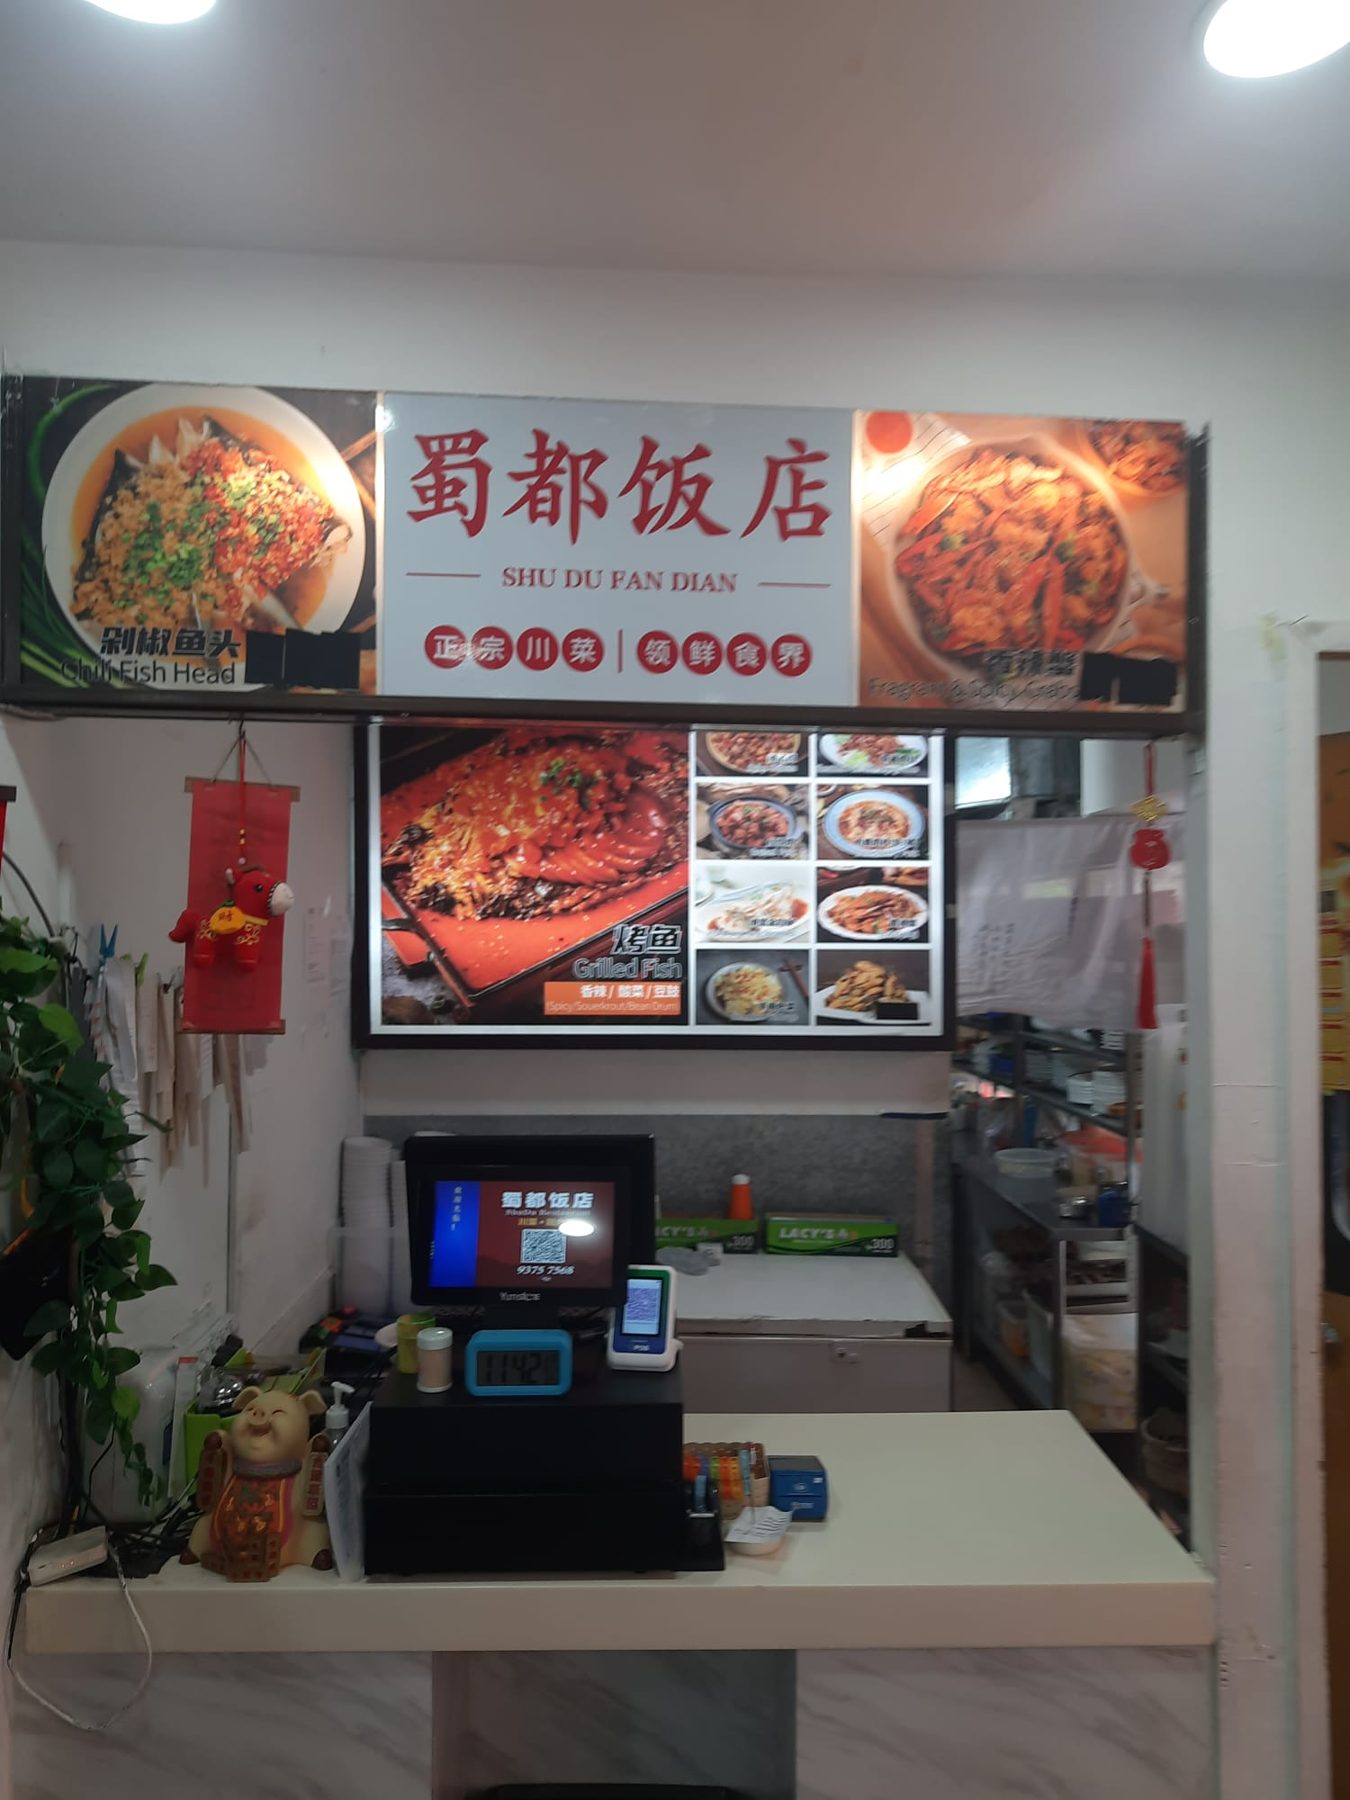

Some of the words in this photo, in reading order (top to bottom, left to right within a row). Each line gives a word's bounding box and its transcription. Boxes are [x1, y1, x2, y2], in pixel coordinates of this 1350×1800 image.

[406, 427, 832, 546] 蜀都饭店
[501, 567, 555, 587] SHU
[564, 569, 602, 589] DU
[611, 570, 663, 591] FAN
[671, 572, 738, 593] DIAN
[100, 626, 241, 659] 剁椒鱼头
[432, 633, 598, 665] 正宗川菜
[119, 660, 166, 684] Fish
[174, 661, 235, 685] Head
[612, 923, 683, 955] 烤鱼
[573, 957, 638, 980] Grilled
[641, 957, 683, 979] Fish
[501, 1191, 594, 1209] 蜀都饭店
